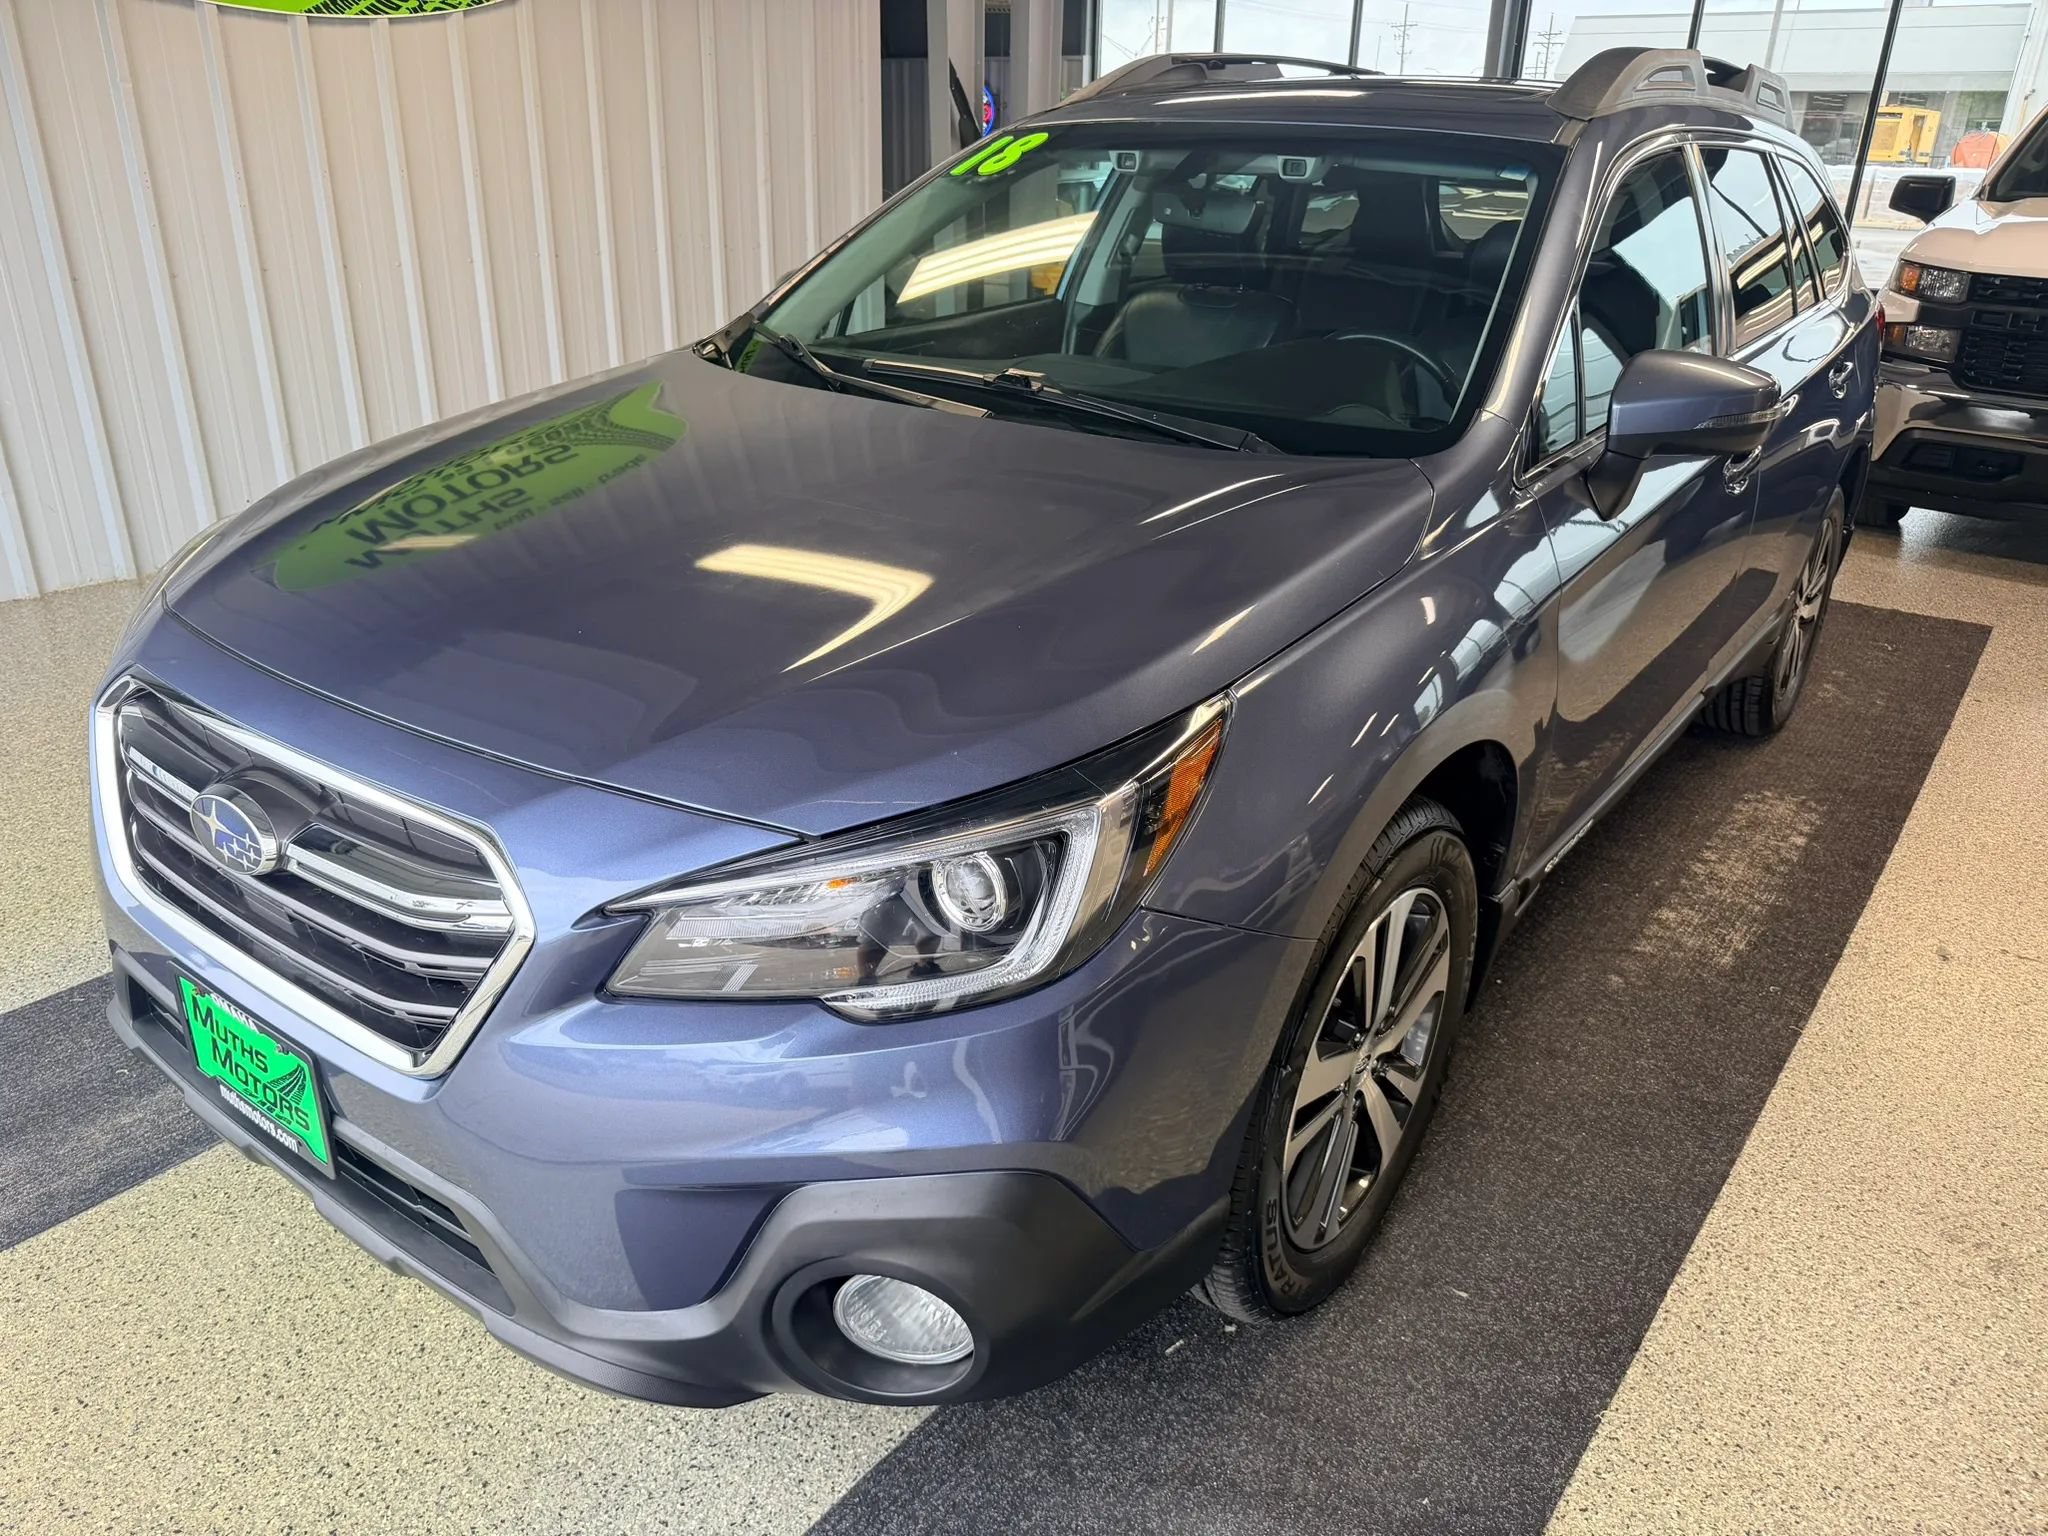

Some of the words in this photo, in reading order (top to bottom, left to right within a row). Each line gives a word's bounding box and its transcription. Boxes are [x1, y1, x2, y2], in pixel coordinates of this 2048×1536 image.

[950, 132, 1049, 175] 18
[193, 995, 269, 1074] MUTHS
[212, 1038, 310, 1132] MOTORS
[220, 1084, 299, 1154] muthsmotors.com
[1265, 1198, 1304, 1296] RATUS
